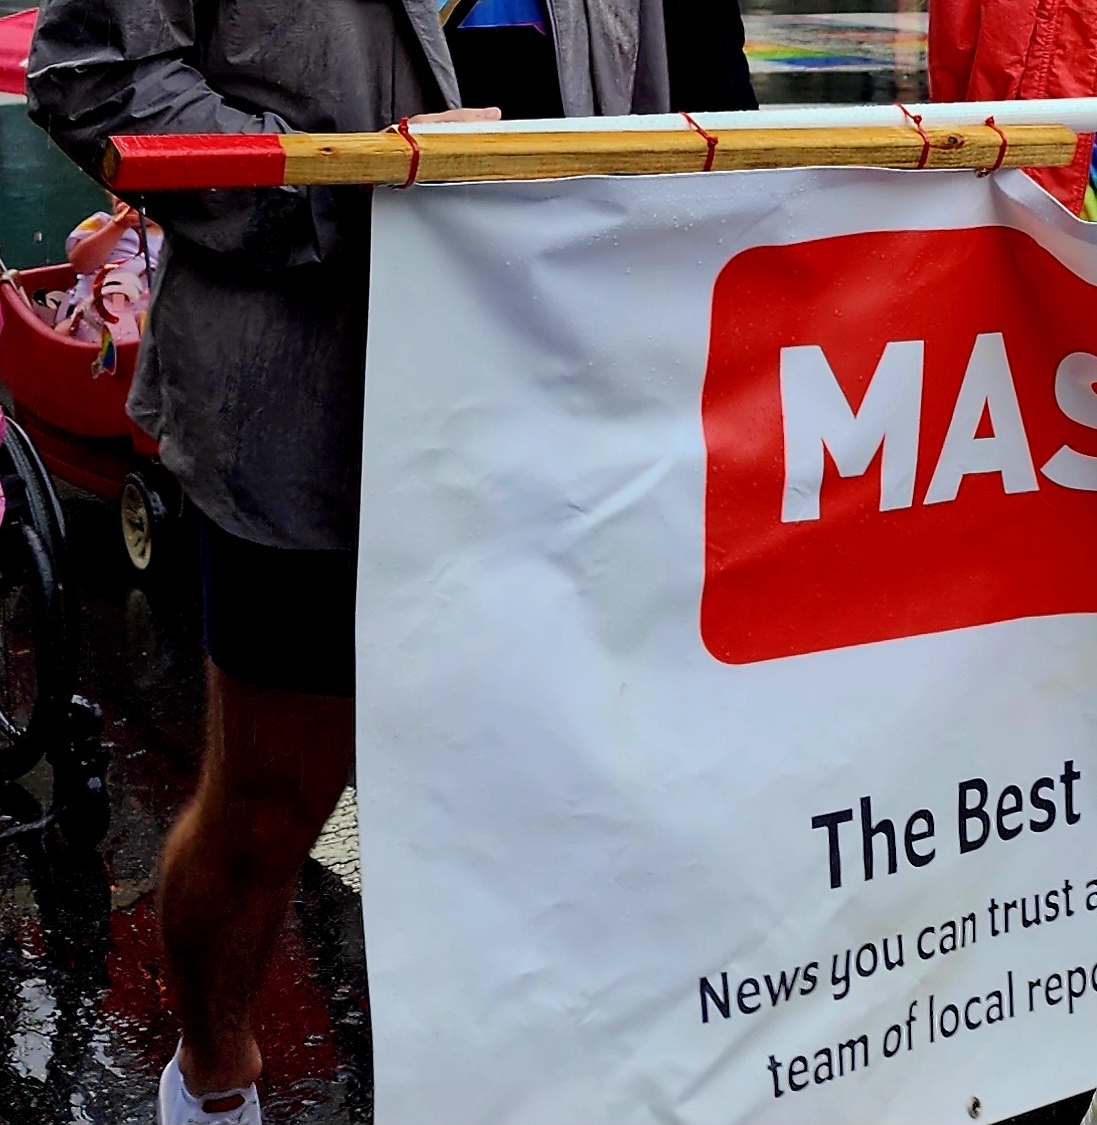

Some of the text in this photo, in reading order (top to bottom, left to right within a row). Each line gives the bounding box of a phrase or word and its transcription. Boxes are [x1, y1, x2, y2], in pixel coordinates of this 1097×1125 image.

[811, 795, 936, 889] The
[958, 759, 1082, 854] Best
[699, 961, 820, 1024] News
[830, 934, 905, 1000] you
[916, 912, 977, 960] can
[988, 879, 1075, 937] trust
[767, 1034, 870, 1099] team
[882, 1000, 918, 1059] of
[928, 970, 1016, 1044] local
